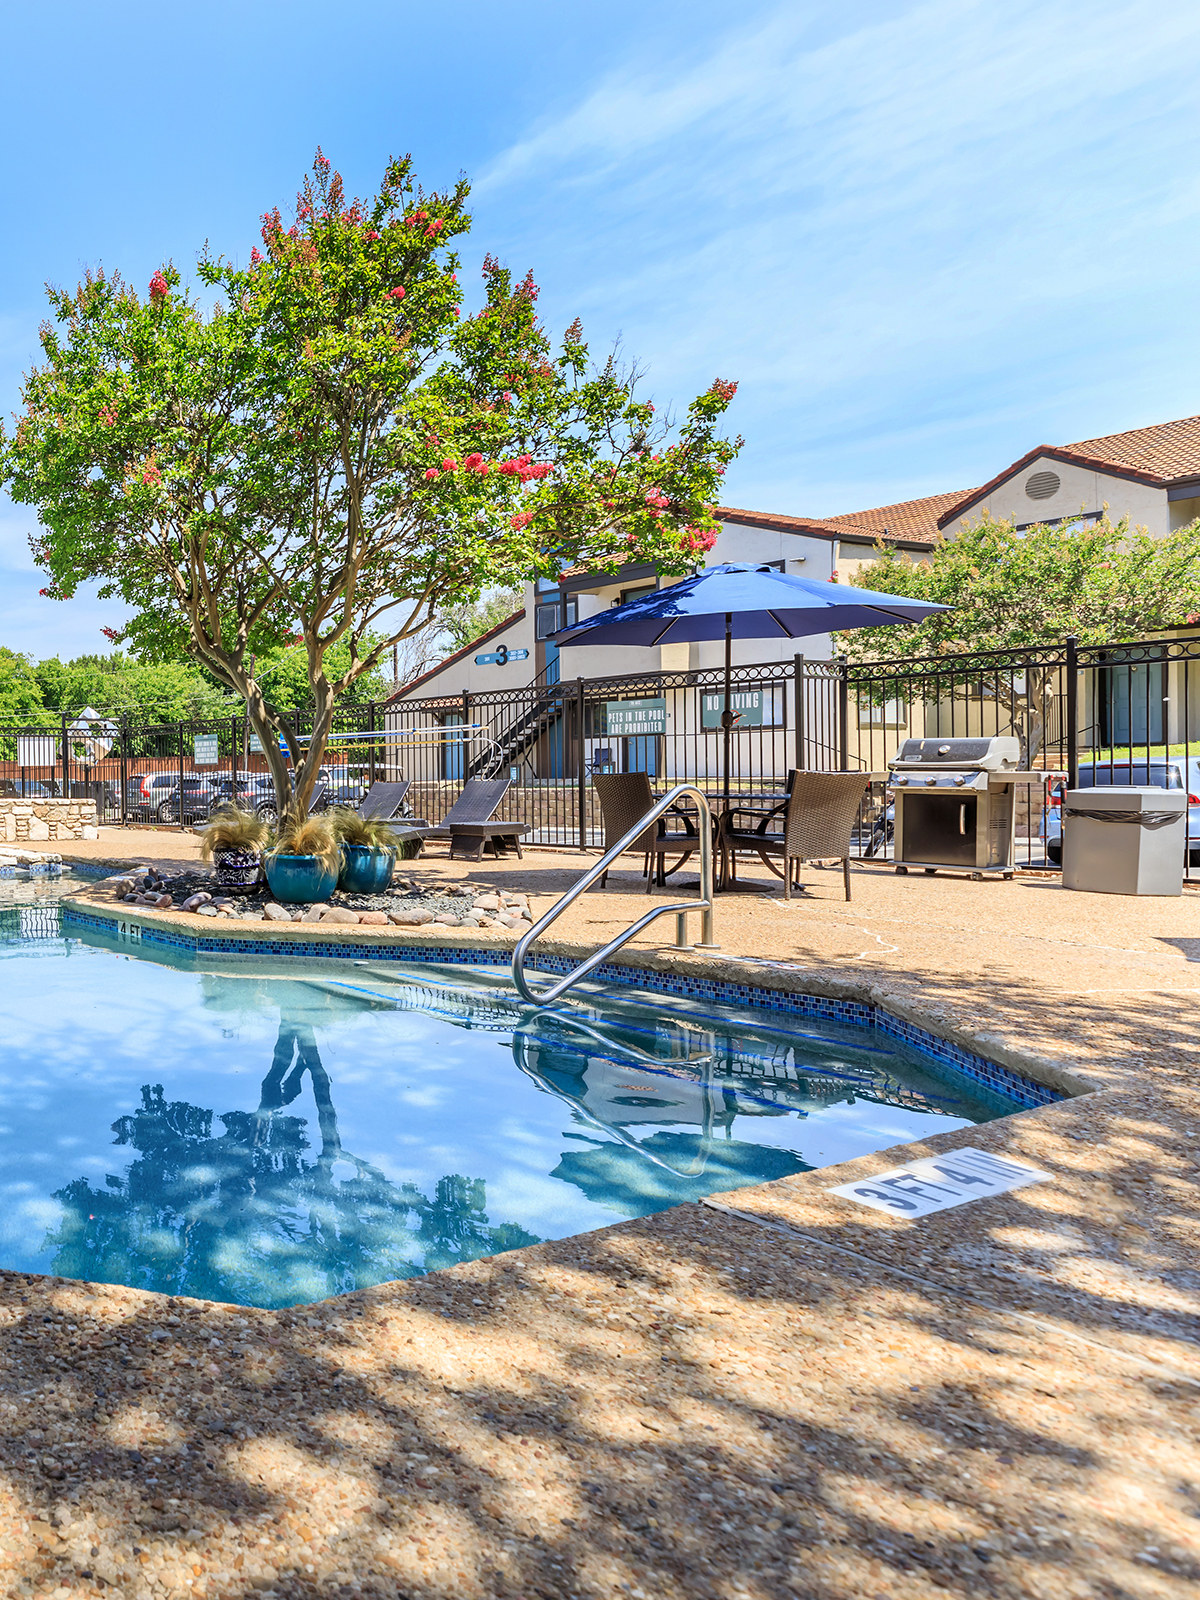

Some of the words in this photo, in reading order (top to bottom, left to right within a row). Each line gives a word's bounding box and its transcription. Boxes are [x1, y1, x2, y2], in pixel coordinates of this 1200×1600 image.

[495, 644, 508, 667] 3
[707, 695, 719, 711] NO
[730, 692, 759, 710] IVING
[608, 711, 623, 723] PETS
[625, 711, 633, 722] IN
[634, 710, 646, 722] THE
[648, 709, 665, 721] POOL
[611, 723, 623, 734] ARE
[624, 721, 663, 734] PROHIBITED
[120, 922, 127, 934] 4
[130, 924, 140, 937] FT
[932, 1164, 996, 1187] 4
[954, 1152, 1034, 1180] IN
[853, 1187, 919, 1211] 3
[881, 1173, 963, 1203] FT
